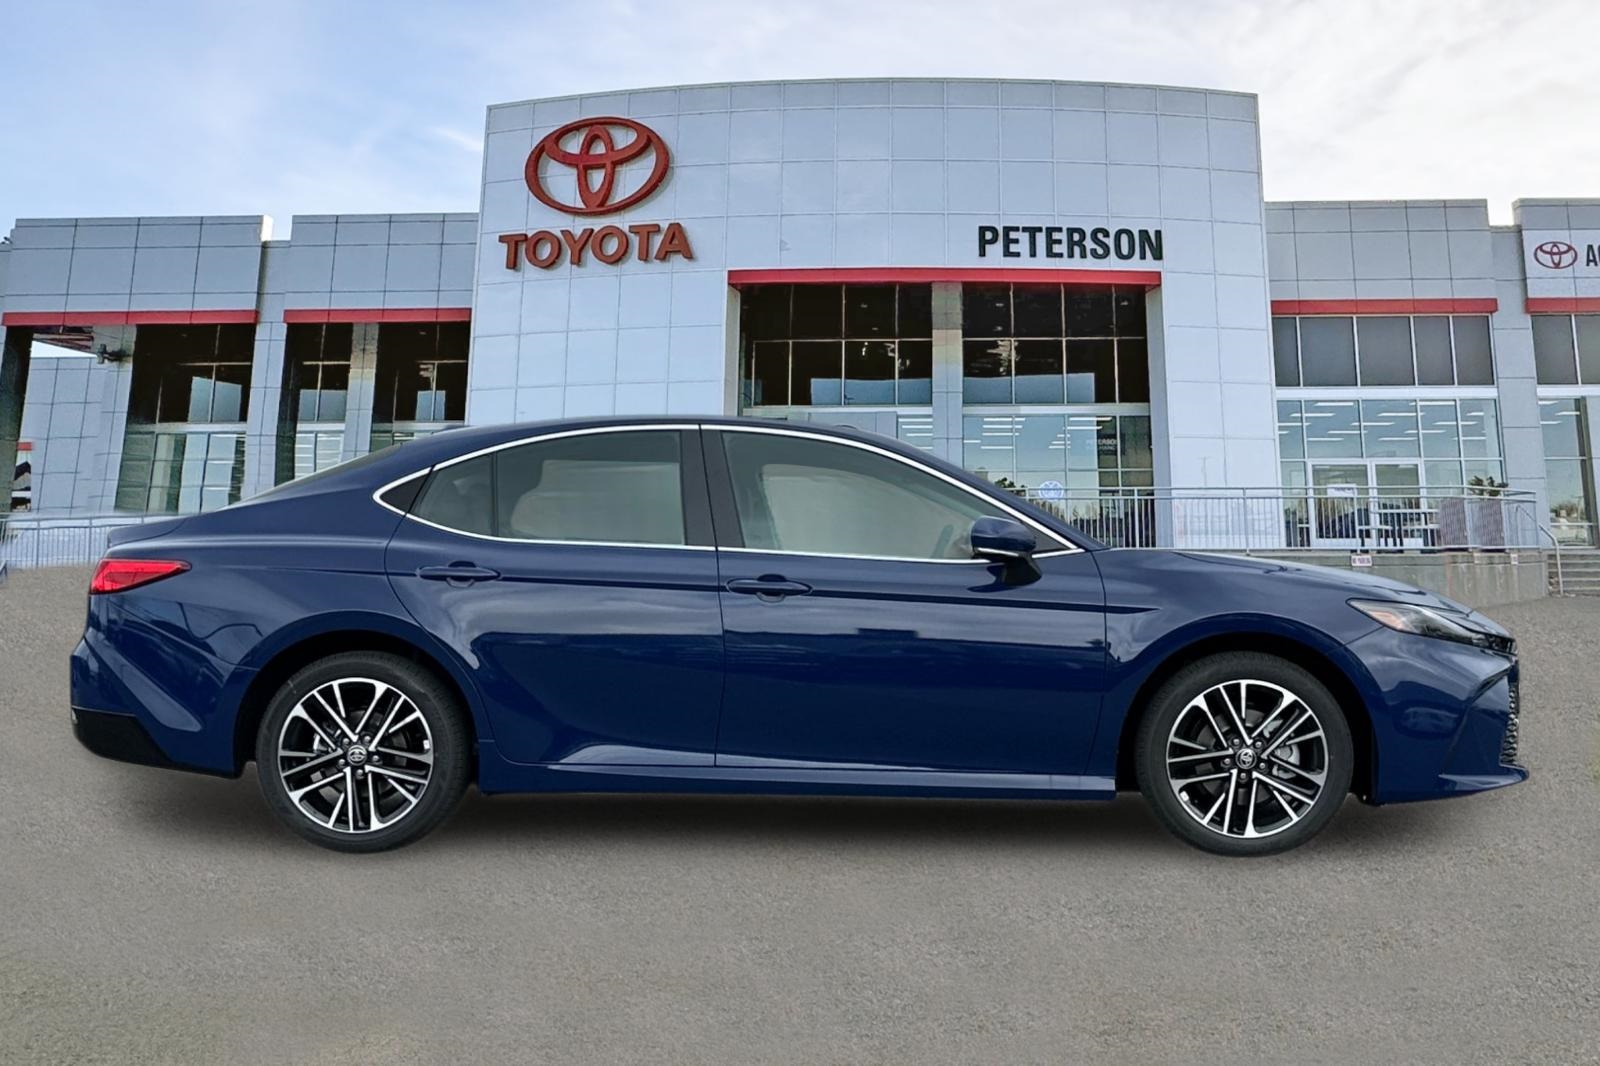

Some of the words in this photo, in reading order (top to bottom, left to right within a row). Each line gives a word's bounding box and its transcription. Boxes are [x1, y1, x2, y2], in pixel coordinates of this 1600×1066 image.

[498, 223, 694, 270] TOYOTA
[978, 225, 1164, 261] PETERSON
[1586, 244, 1600, 267] A
